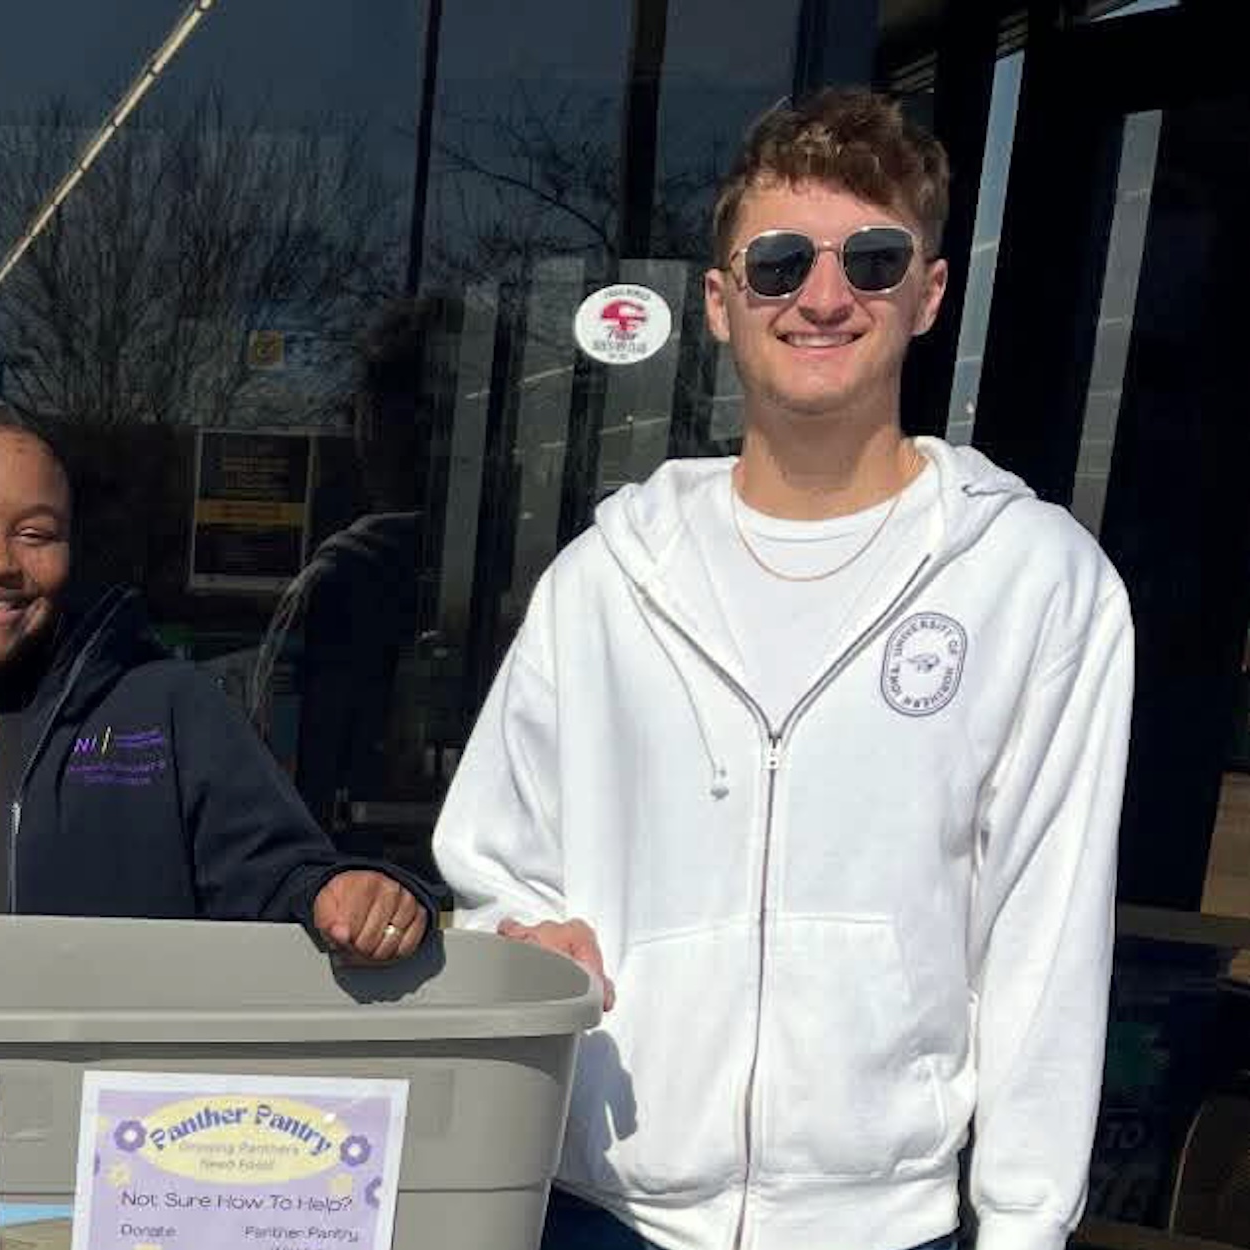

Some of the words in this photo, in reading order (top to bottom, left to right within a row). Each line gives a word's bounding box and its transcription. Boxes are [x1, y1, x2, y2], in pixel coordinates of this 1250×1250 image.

[149, 1107, 248, 1151] Panther
[254, 1104, 332, 1156] Pantry
[121, 1190, 158, 1207] Not
[164, 1191, 211, 1208] Sure
[217, 1192, 265, 1209] How
[270, 1193, 293, 1211] To
[299, 1194, 352, 1215] Help?
[121, 1223, 177, 1238] Donate
[244, 1225, 304, 1239] Panther
[307, 1227, 359, 1243] Pantry
